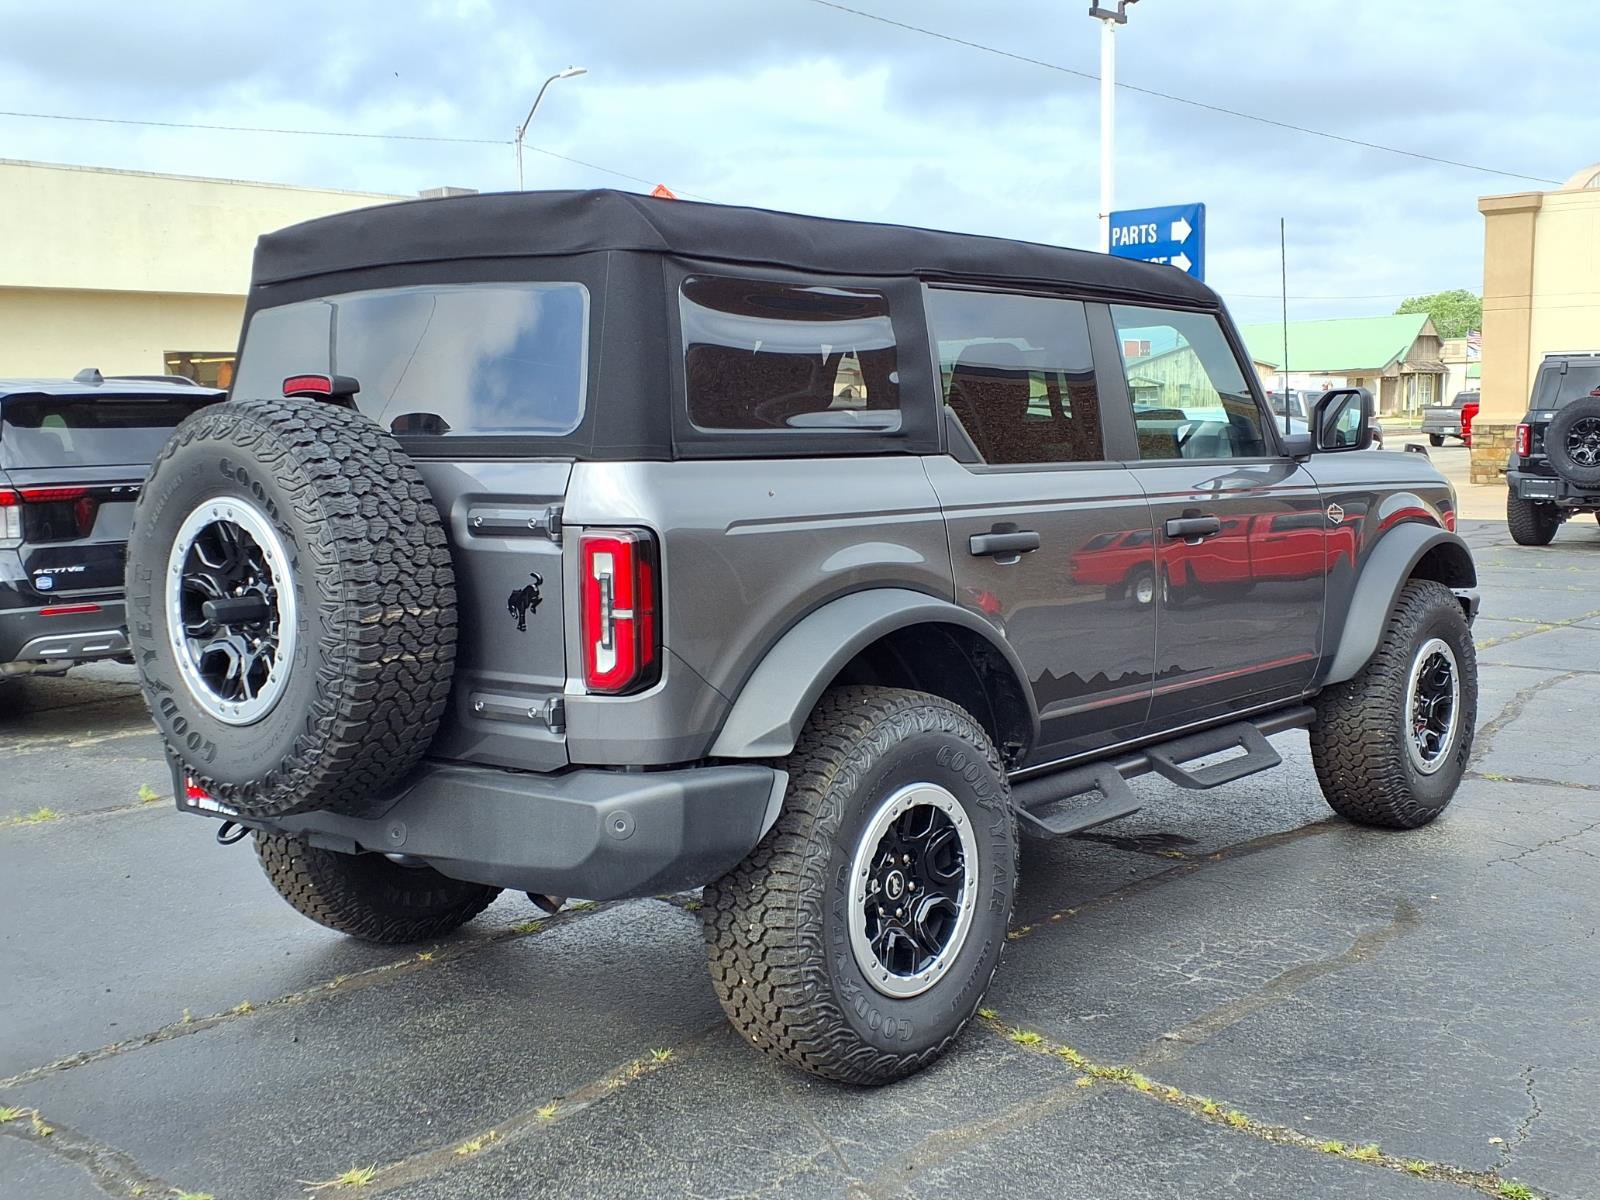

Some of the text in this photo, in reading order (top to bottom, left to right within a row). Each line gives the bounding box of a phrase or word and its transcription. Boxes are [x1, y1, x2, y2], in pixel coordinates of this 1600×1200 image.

[1111, 223, 1157, 247] PARTS
[32, 566, 86, 575] ACTIVE
[136, 565, 218, 764] GOODYEAR
[935, 744, 1008, 914] GOODYEAR
[832, 864, 915, 1042] GOODYEAR
